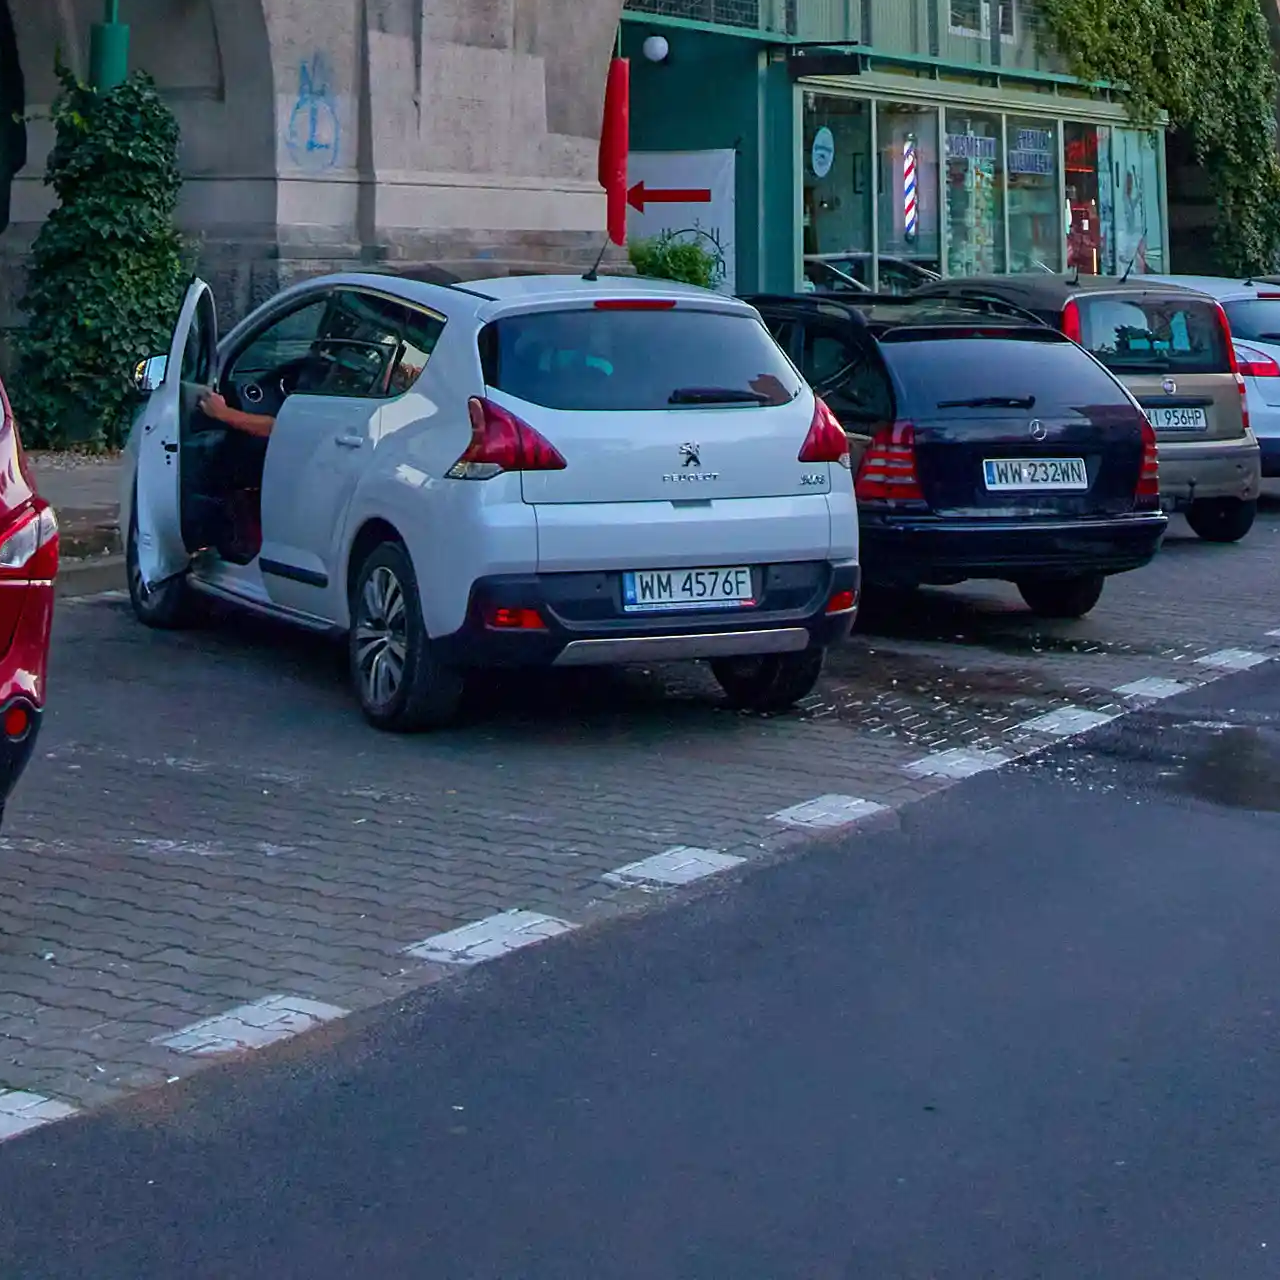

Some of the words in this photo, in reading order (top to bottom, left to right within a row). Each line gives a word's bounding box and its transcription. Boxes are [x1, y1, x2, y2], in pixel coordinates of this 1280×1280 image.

[1164, 410, 1202, 425] 956HP
[996, 462, 1023, 483] WW
[639, 573, 673, 600] WM
[681, 570, 747, 597] 4576F
